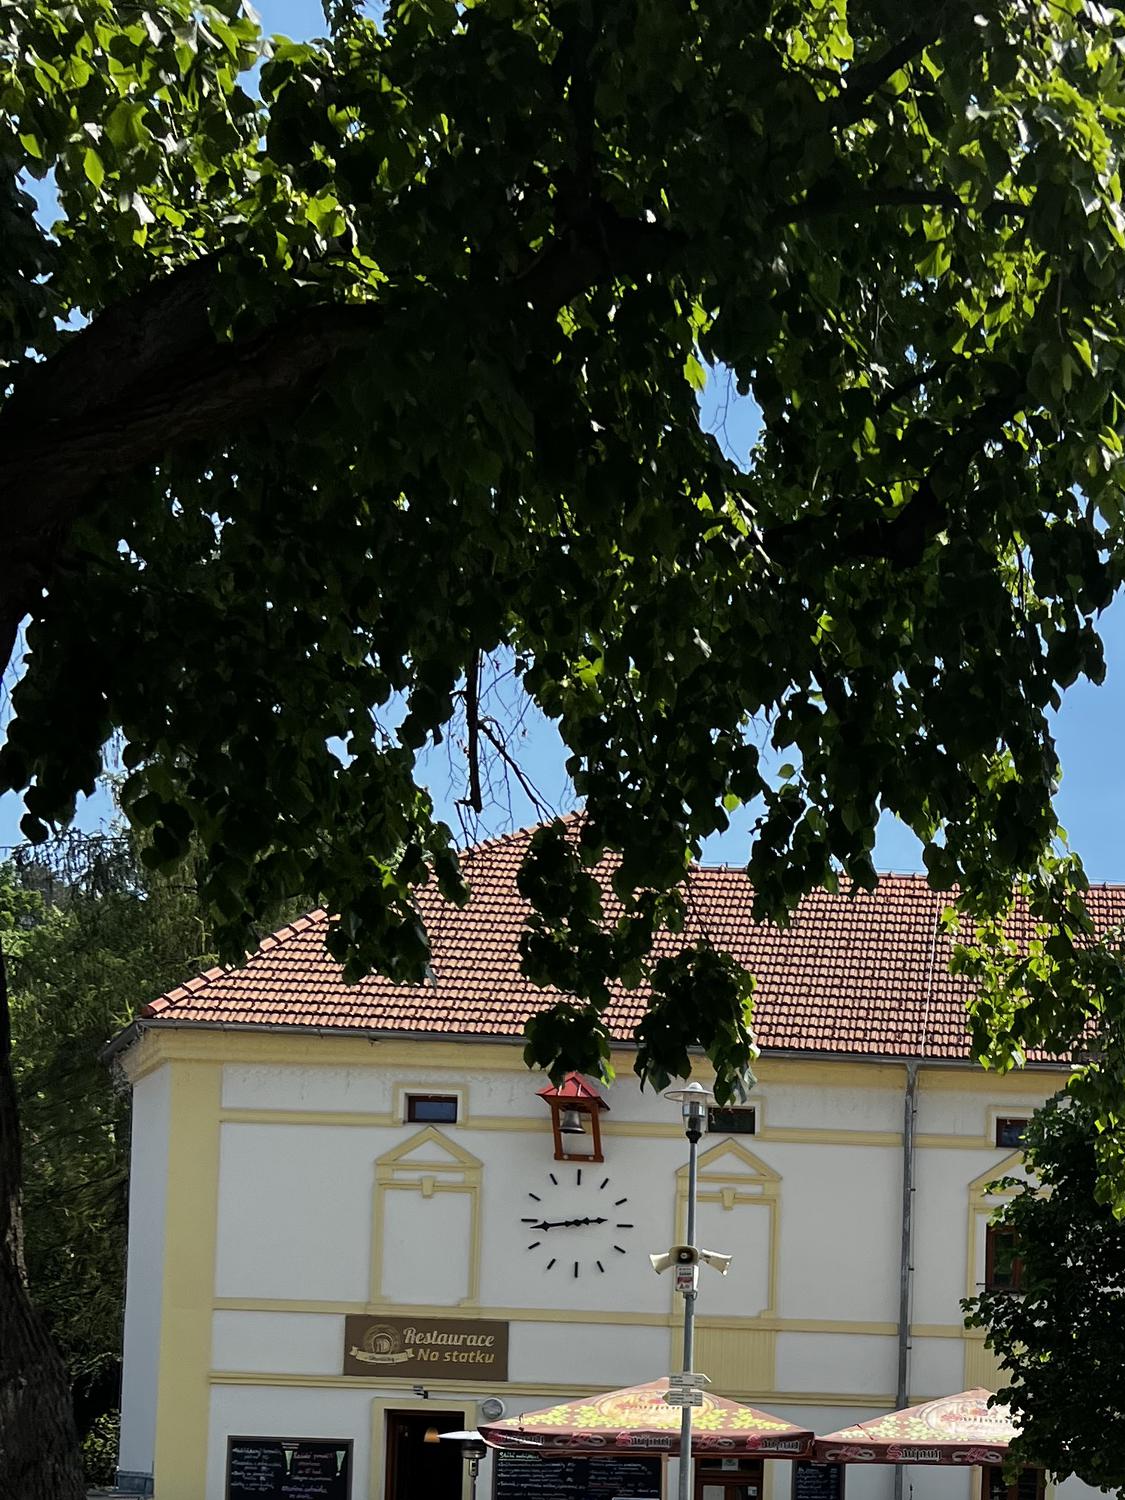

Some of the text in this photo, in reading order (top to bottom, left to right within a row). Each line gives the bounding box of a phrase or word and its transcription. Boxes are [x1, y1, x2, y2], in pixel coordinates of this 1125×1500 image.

[403, 1327, 495, 1346] Restaurace
[417, 1348, 495, 1363] Na statku
